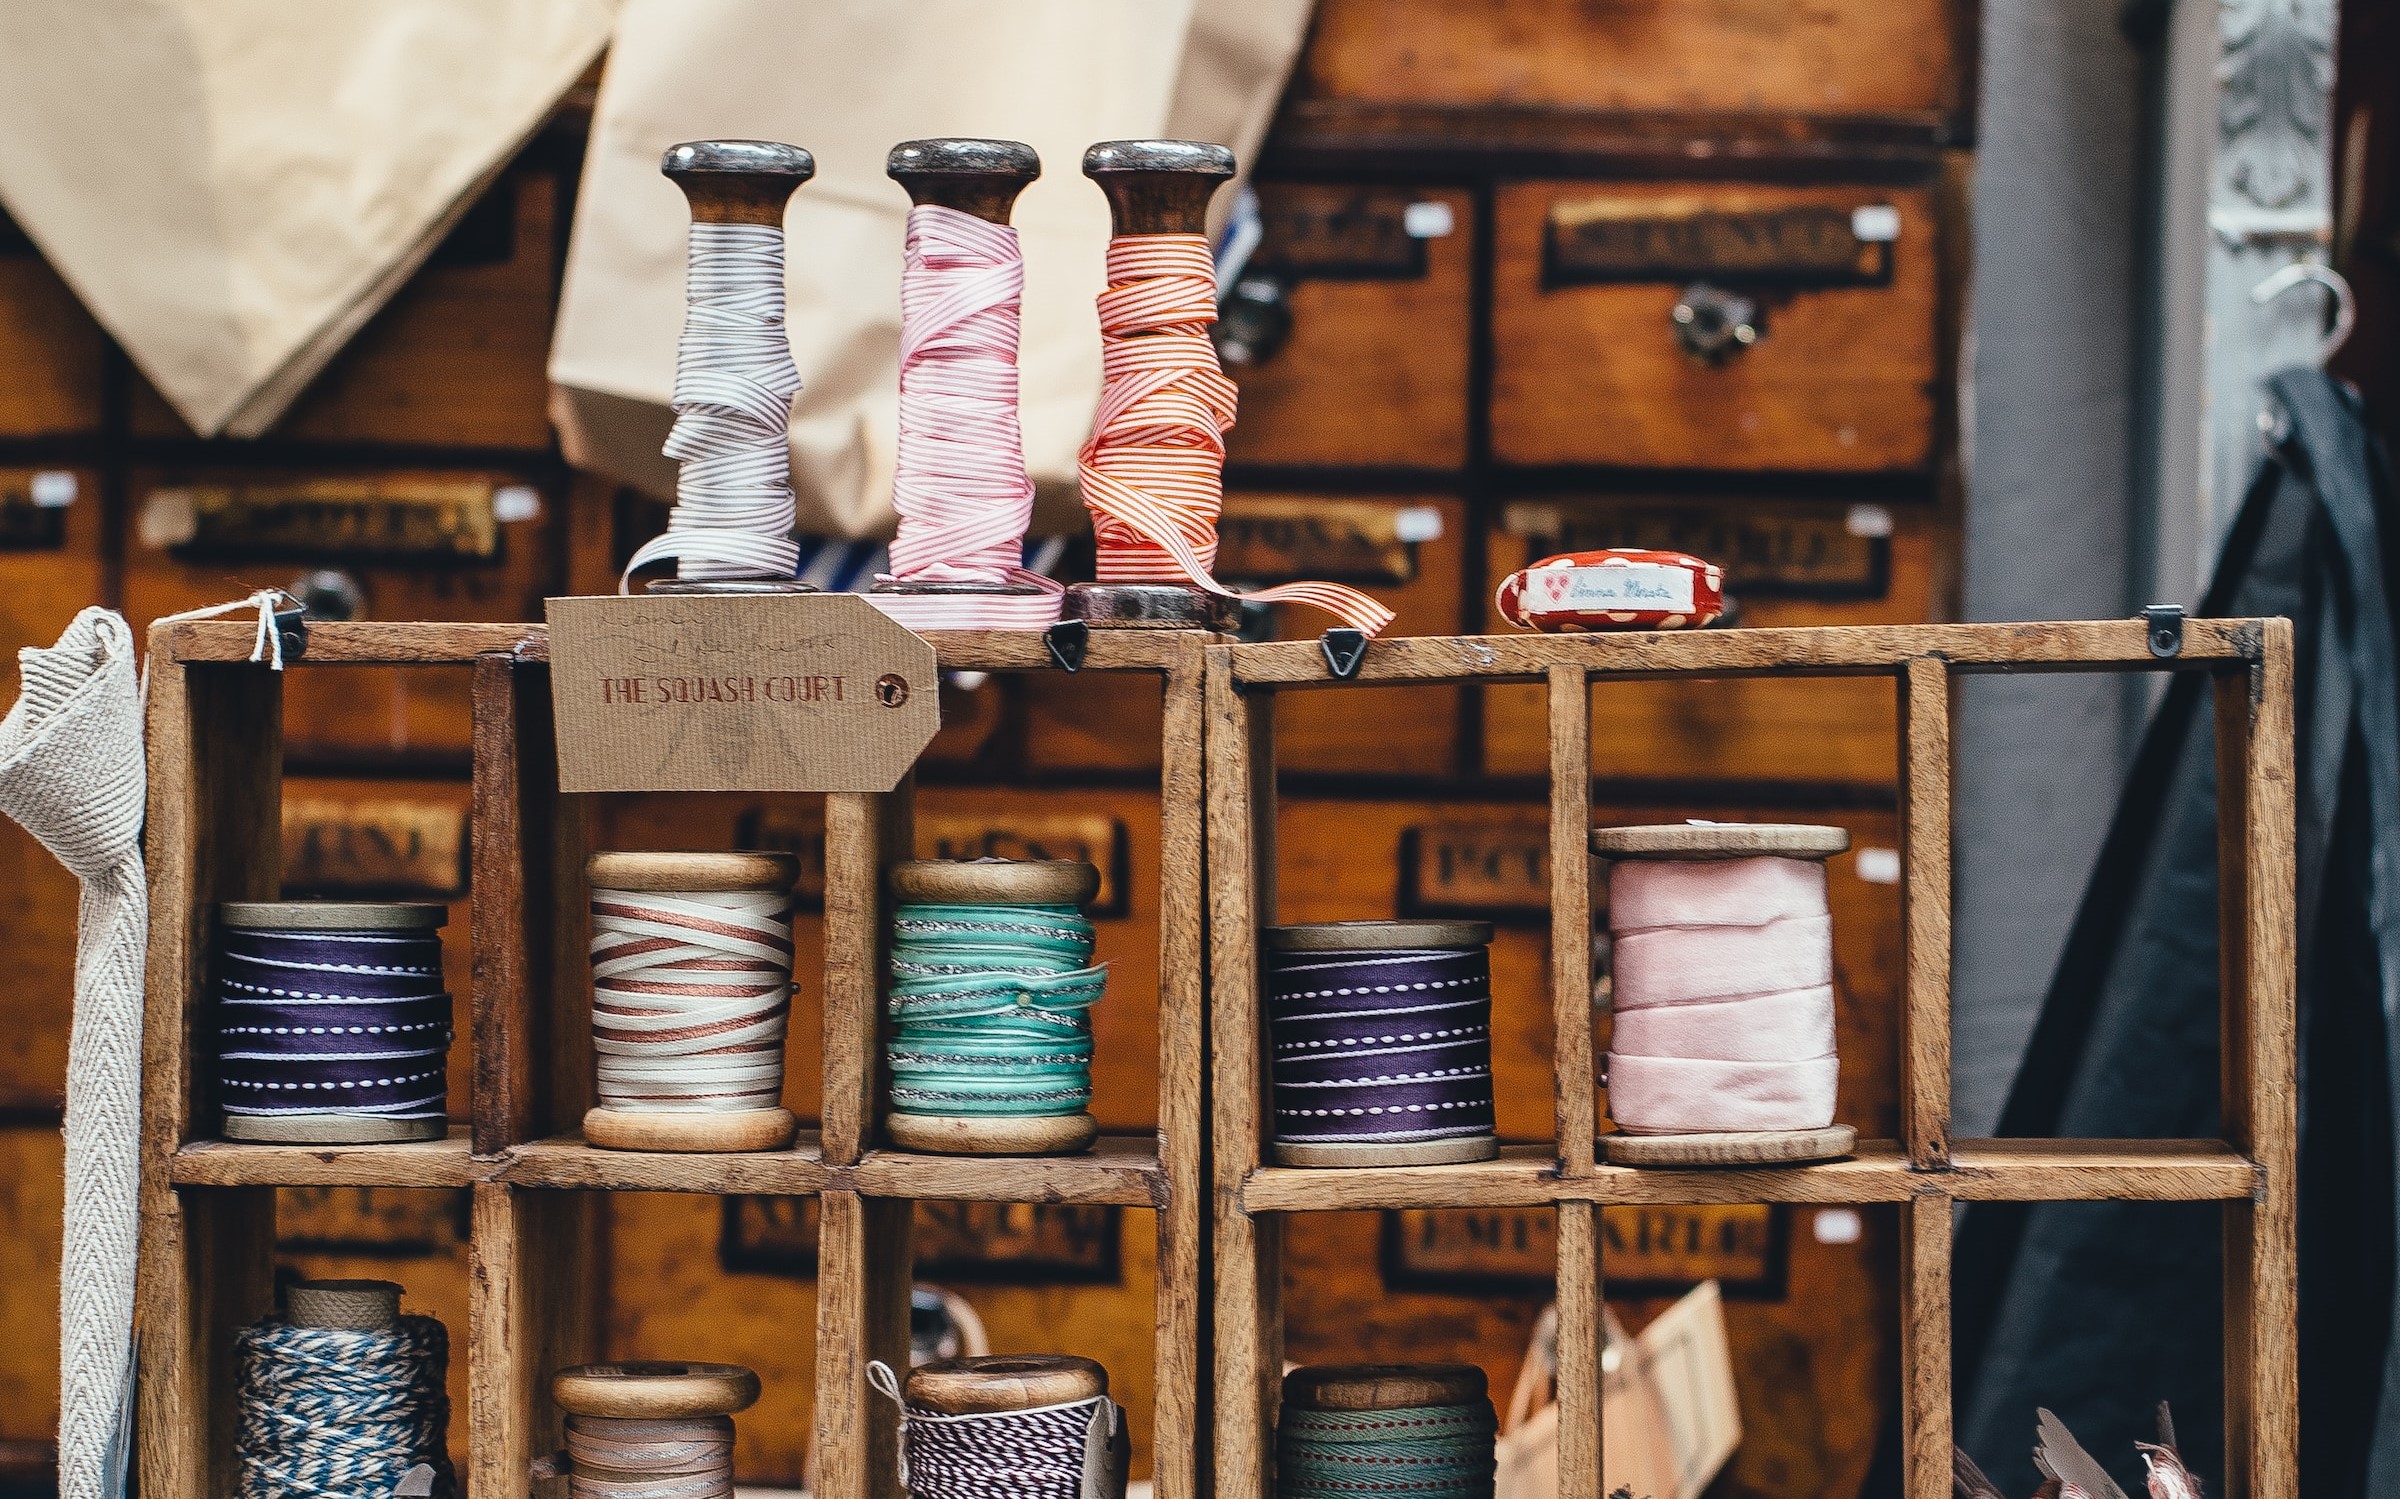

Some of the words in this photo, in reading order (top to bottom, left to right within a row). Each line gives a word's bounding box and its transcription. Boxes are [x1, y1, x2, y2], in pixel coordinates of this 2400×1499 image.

[600, 677, 649, 704] THE
[655, 676, 756, 703] SQUASH
[763, 675, 849, 703] COURT
